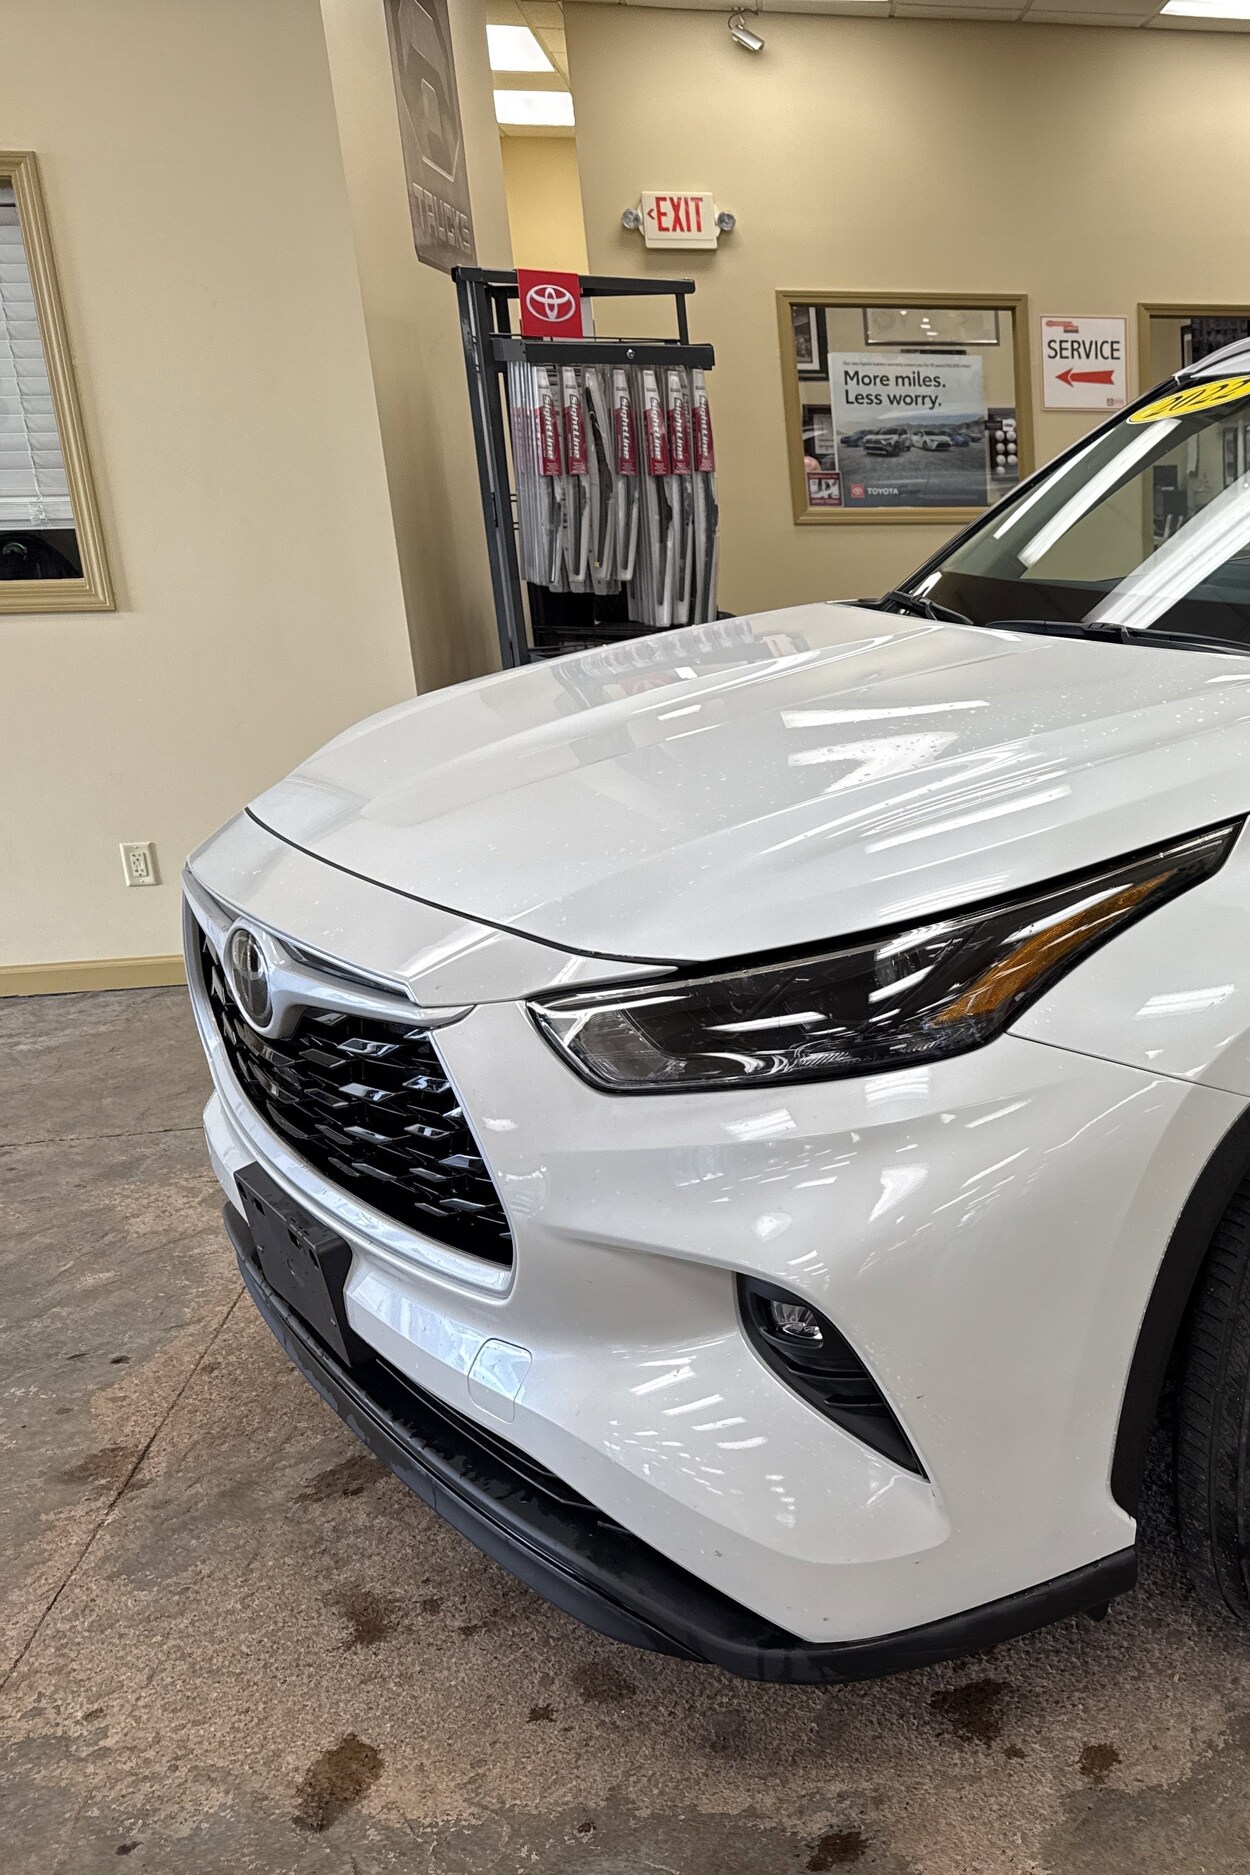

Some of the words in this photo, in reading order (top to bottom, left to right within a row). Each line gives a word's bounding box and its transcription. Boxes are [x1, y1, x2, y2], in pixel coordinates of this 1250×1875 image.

[655, 196, 703, 232] EXIT
[1047, 339, 1121, 360] SERVICE
[844, 370, 890, 387] More
[895, 371, 946, 388] miles.
[845, 389, 883, 405] Less
[887, 393, 942, 410] worry.
[867, 487, 899, 495] TOYOTA
